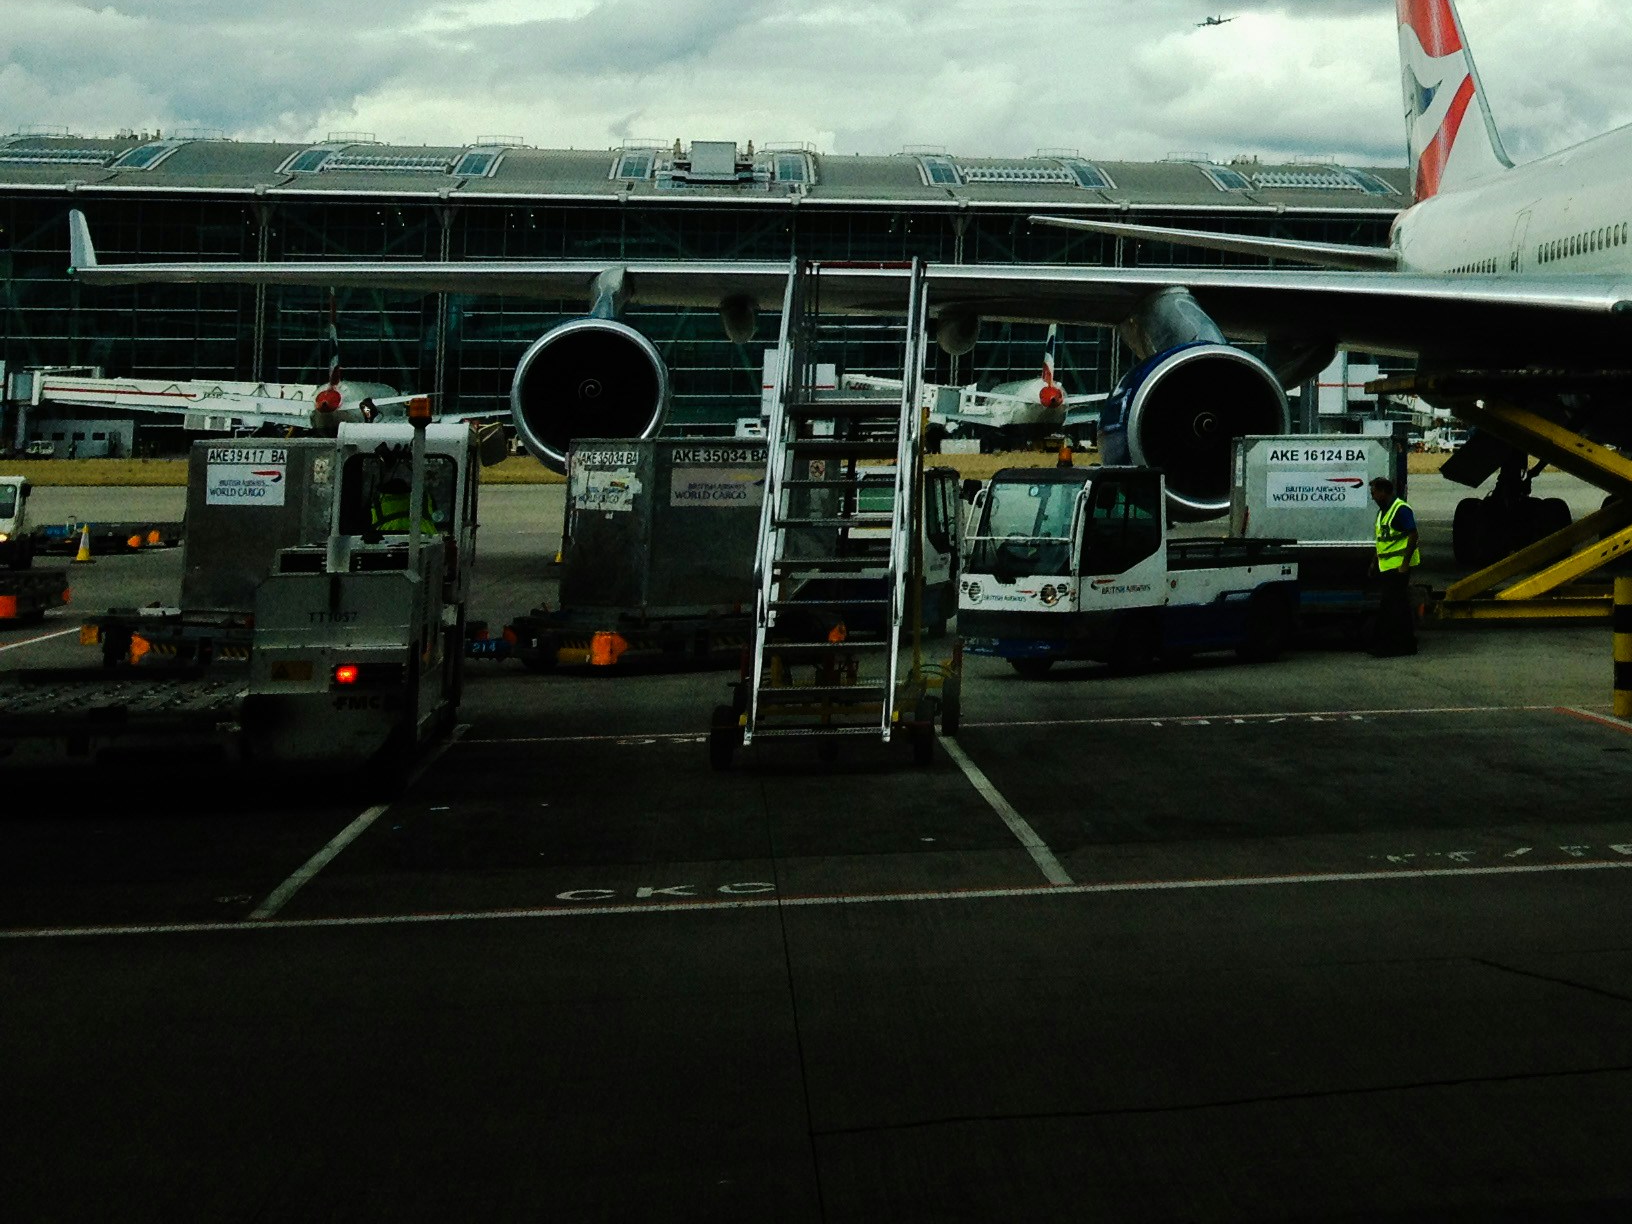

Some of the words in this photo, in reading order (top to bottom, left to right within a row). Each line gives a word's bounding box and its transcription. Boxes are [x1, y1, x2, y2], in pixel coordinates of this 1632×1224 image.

[271, 450, 286, 463] BA
[673, 450, 700, 462] AKE
[703, 450, 747, 462] 35034
[750, 450, 768, 462] BA
[1270, 449, 1299, 461] AKE
[1345, 450, 1366, 461] BA
[209, 487, 236, 497] WORLD
[237, 487, 266, 497] CARGO
[674, 490, 710, 500] WORLD
[712, 490, 747, 500] CARGO
[1272, 492, 1308, 502] WORLD
[1310, 492, 1346, 502] CARGO
